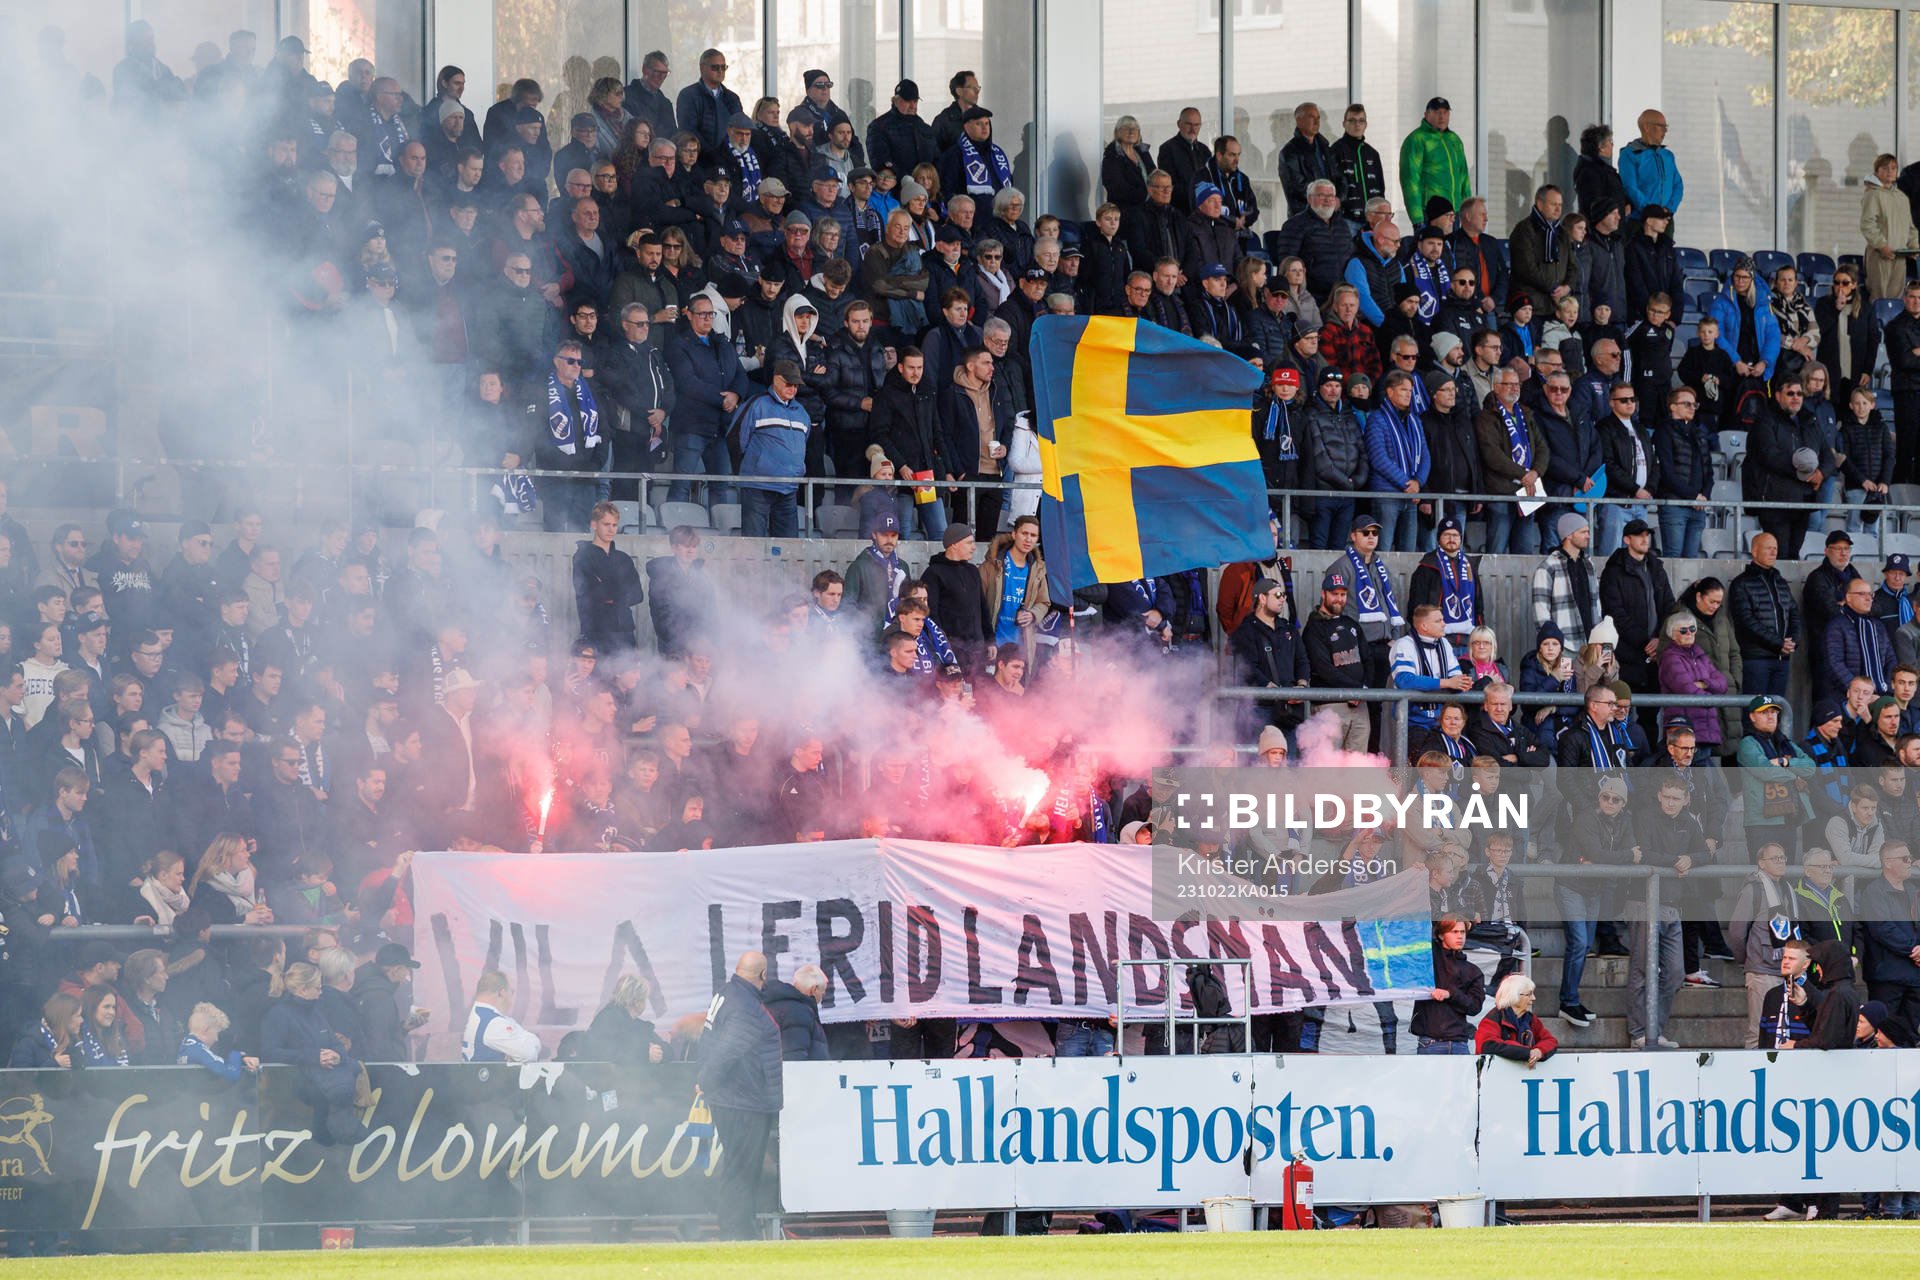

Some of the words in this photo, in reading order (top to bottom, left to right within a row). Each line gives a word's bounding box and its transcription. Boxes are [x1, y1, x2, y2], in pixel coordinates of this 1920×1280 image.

[81, 1094, 325, 1230] fritz
[853, 1075, 1394, 1192] Hallandsposten.
[1521, 1067, 1920, 1181] Hallandspos
